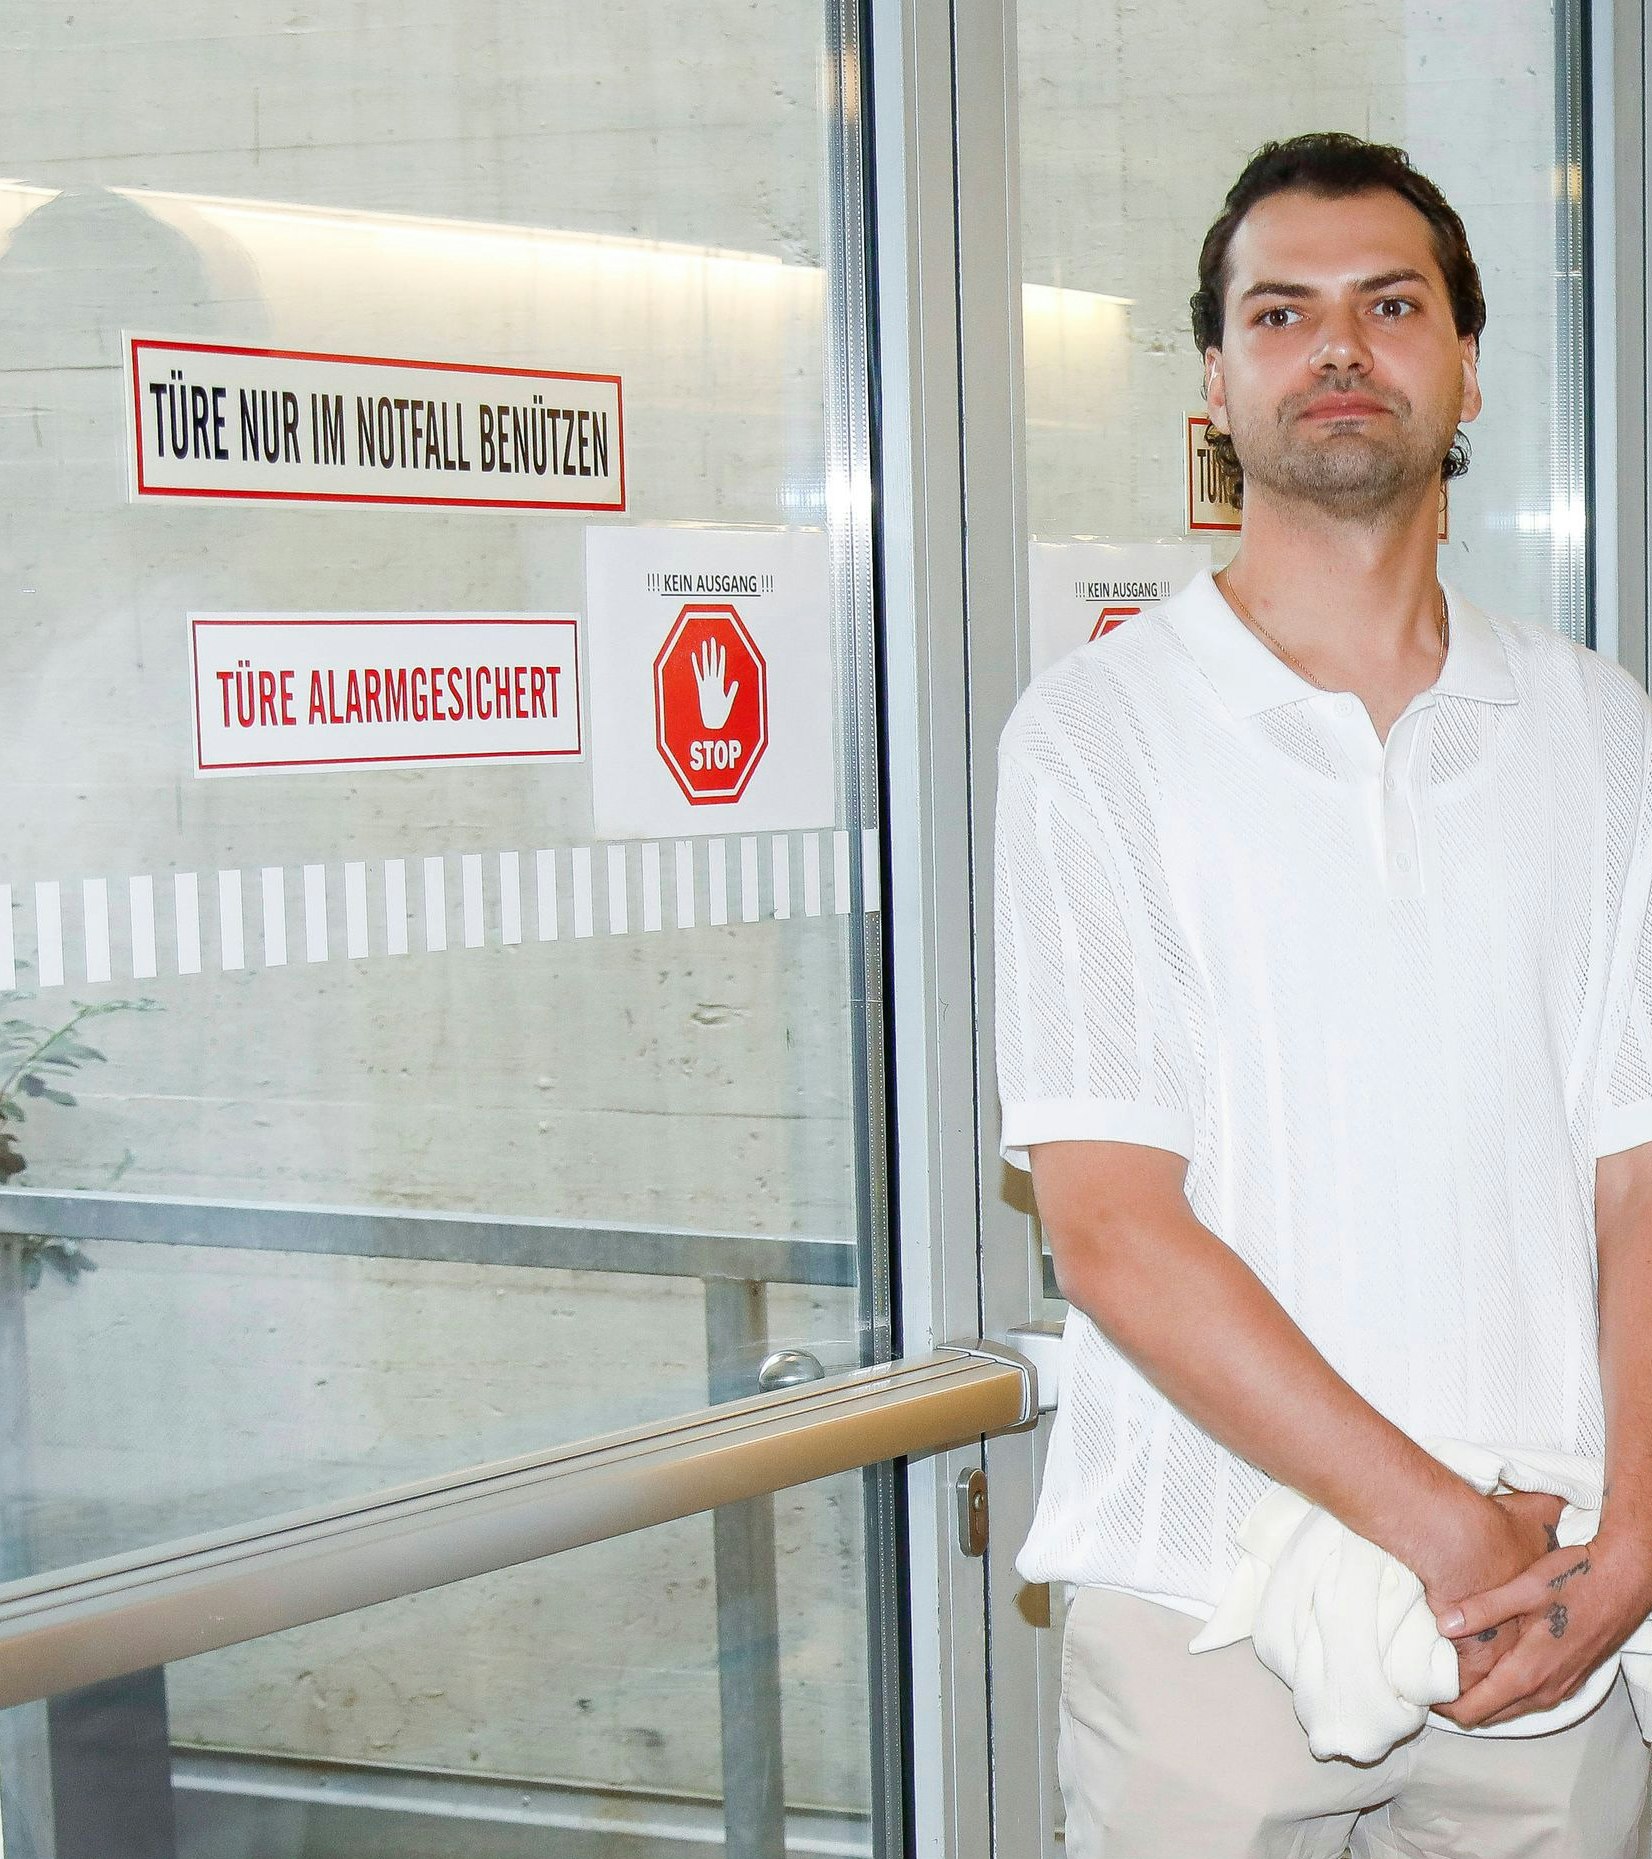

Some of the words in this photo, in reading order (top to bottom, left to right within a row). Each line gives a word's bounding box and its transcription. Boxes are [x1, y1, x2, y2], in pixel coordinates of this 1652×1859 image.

[150, 370, 228, 459] TÜRE
[240, 389, 301, 463] NUR
[312, 394, 346, 466] IM
[357, 397, 471, 471] NOTFALL
[480, 395, 609, 477] BENÜTZEN
[664, 574, 693, 592] KEIN
[697, 574, 757, 593] AUSGANG
[1088, 582, 1110, 598] KEIN
[1113, 582, 1158, 598] AUSGANG
[217, 660, 296, 728] TÜRE
[309, 666, 561, 724] ALARMGESICHERT
[690, 739, 742, 771] STOP
